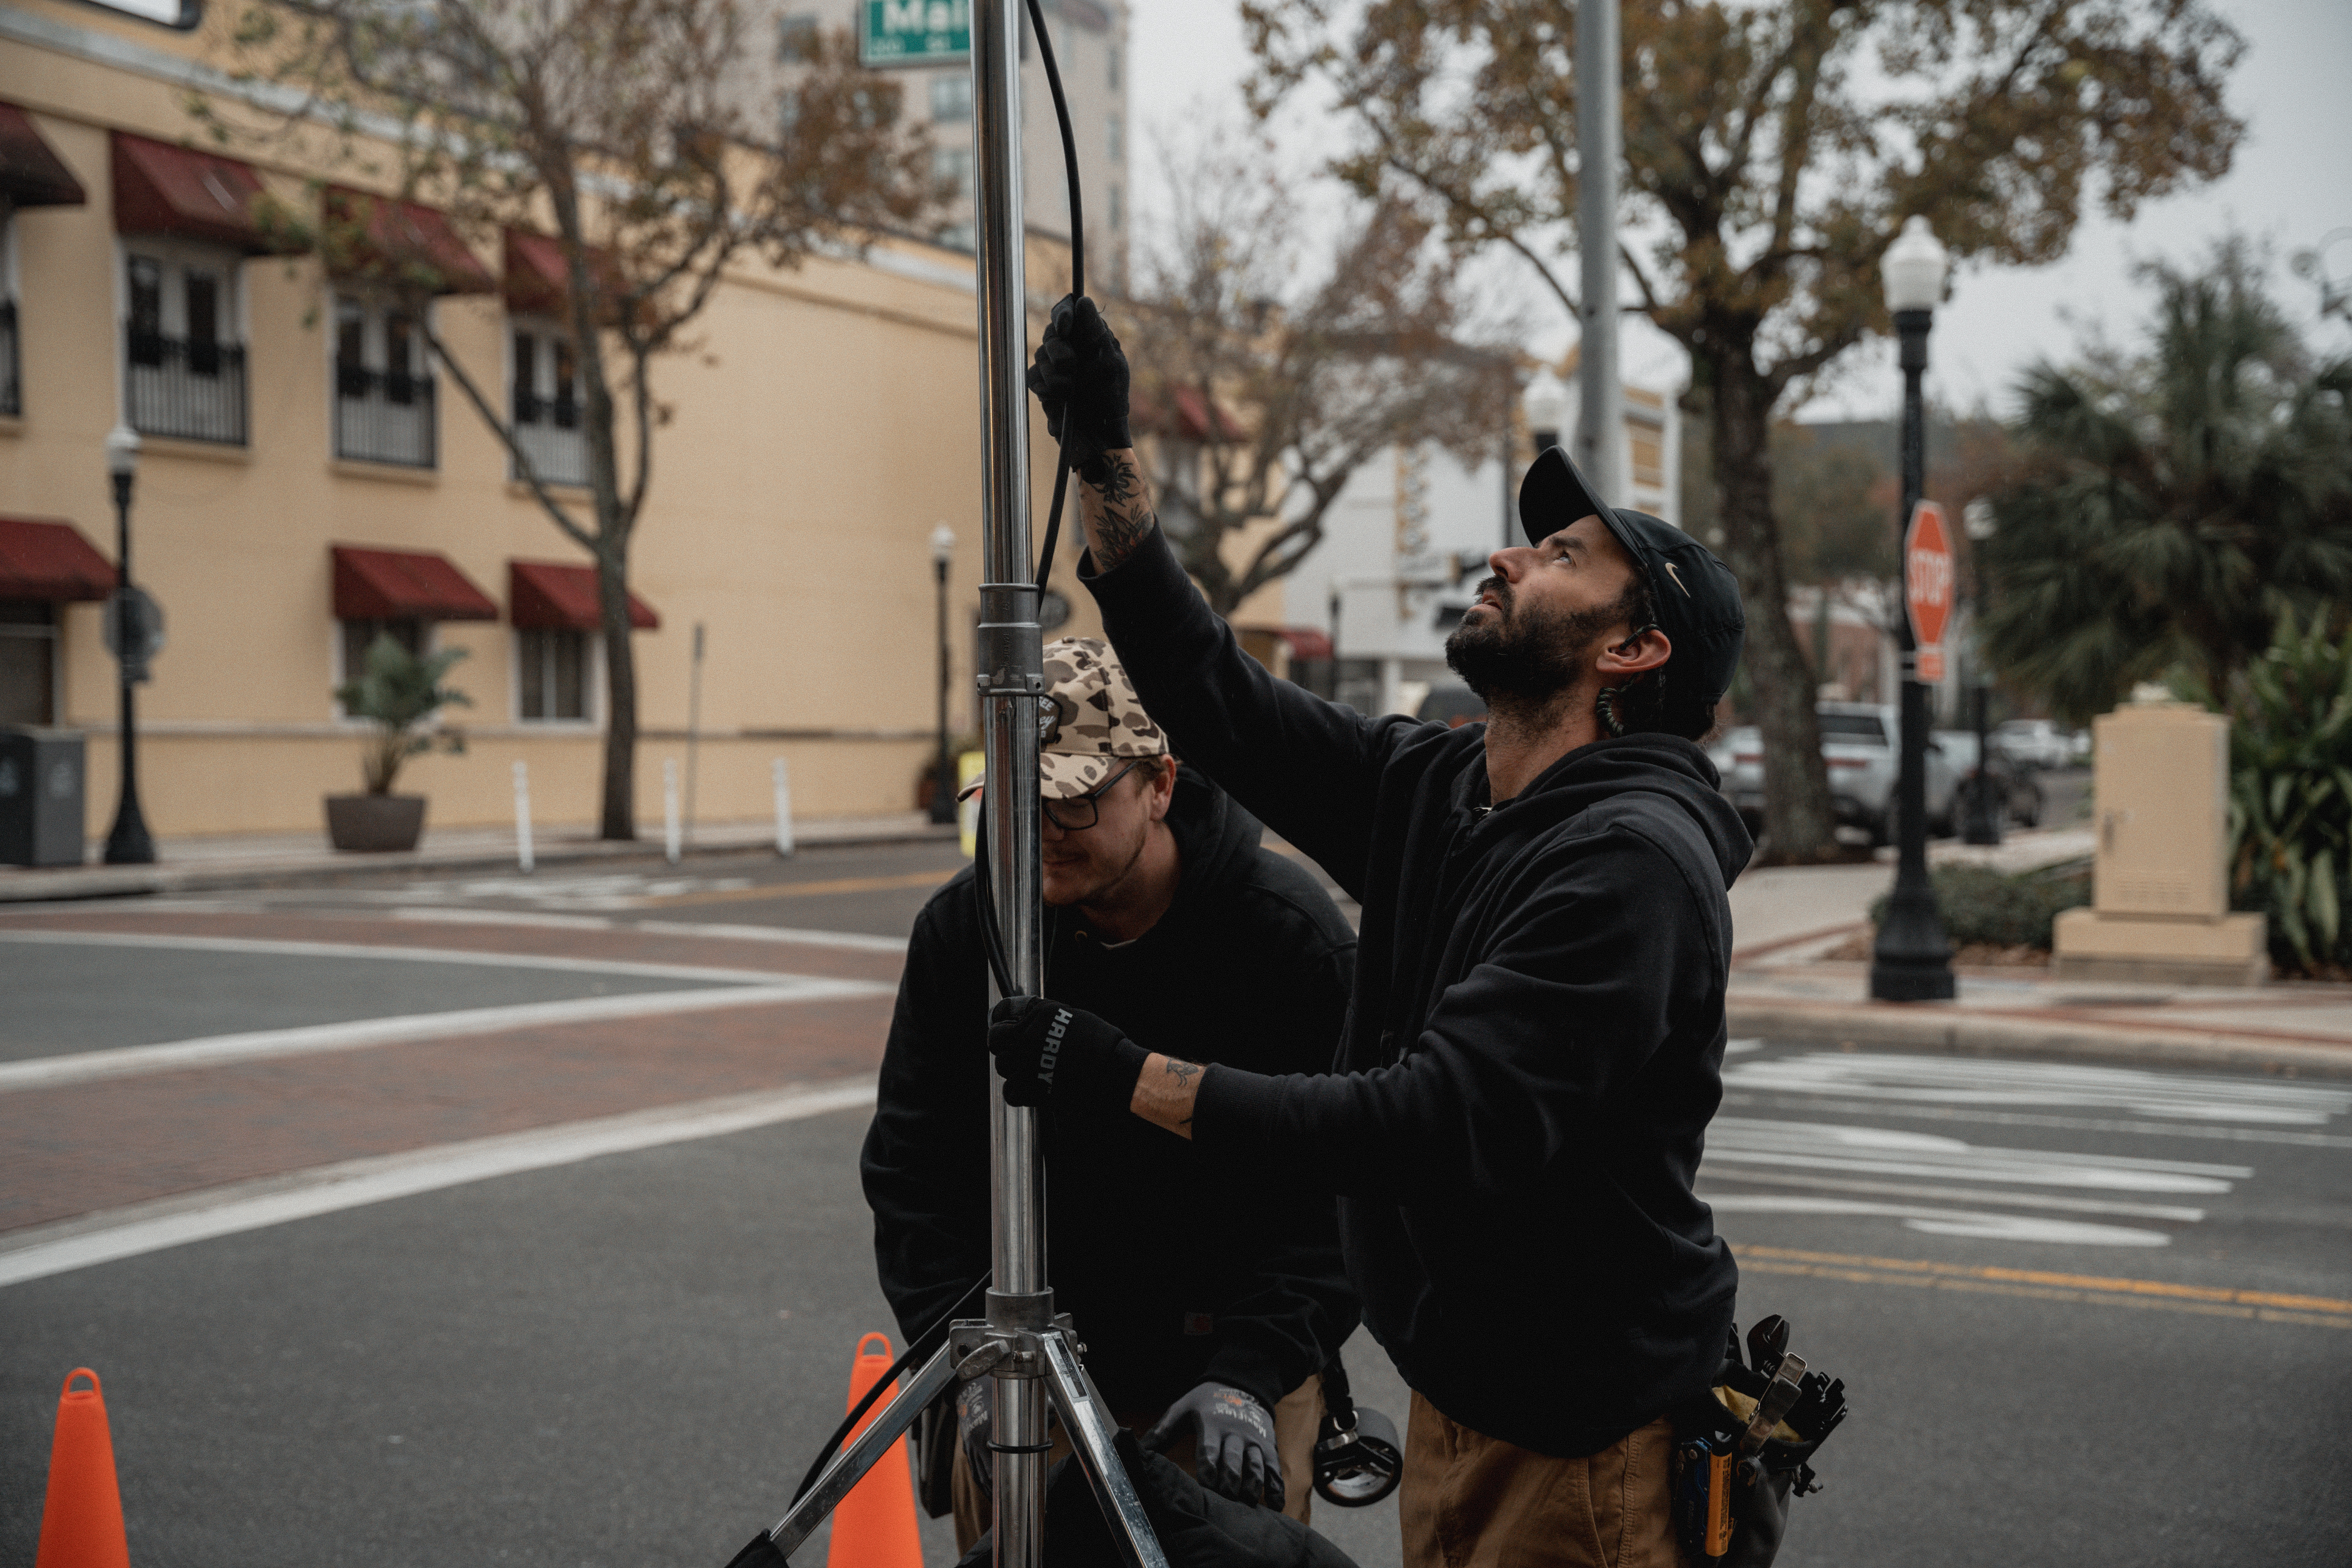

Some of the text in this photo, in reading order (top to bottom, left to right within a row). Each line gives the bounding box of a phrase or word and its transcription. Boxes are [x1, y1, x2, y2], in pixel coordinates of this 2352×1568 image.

[882, 0, 970, 33] Mai
[1908, 550, 1954, 606] STOP
[1037, 1008, 1073, 1085] HARDY
